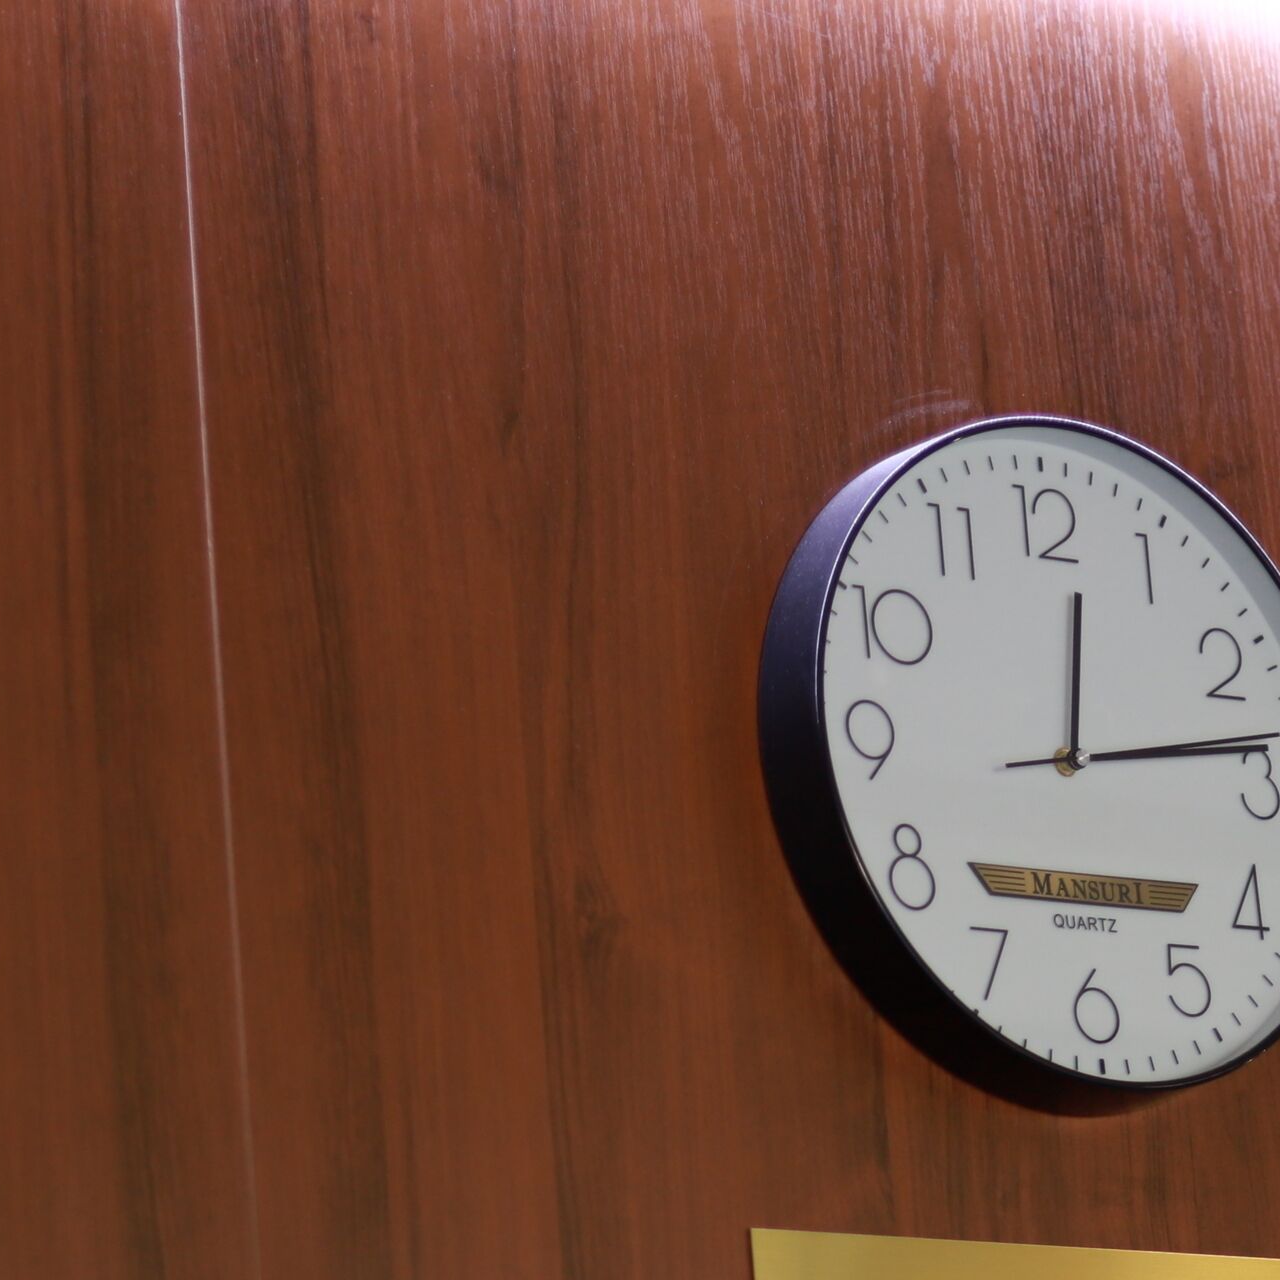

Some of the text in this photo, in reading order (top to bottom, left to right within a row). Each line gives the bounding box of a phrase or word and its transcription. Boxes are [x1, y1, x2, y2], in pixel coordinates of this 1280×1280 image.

[927, 502, 975, 581] 11
[1011, 483, 1079, 564] 12
[1134, 532, 1154, 605] 1
[851, 584, 933, 666] 10
[1199, 627, 1247, 702] 2
[845, 699, 896, 781] 9
[1240, 748, 1280, 821] 3
[888, 823, 937, 912] 8
[1031, 871, 1145, 905] MANSURI
[1231, 863, 1271, 940] 4
[1053, 913, 1118, 933] QUARTZ
[969, 925, 1009, 1001] 7
[1167, 942, 1212, 1019] 5
[1073, 968, 1120, 1045] 6
